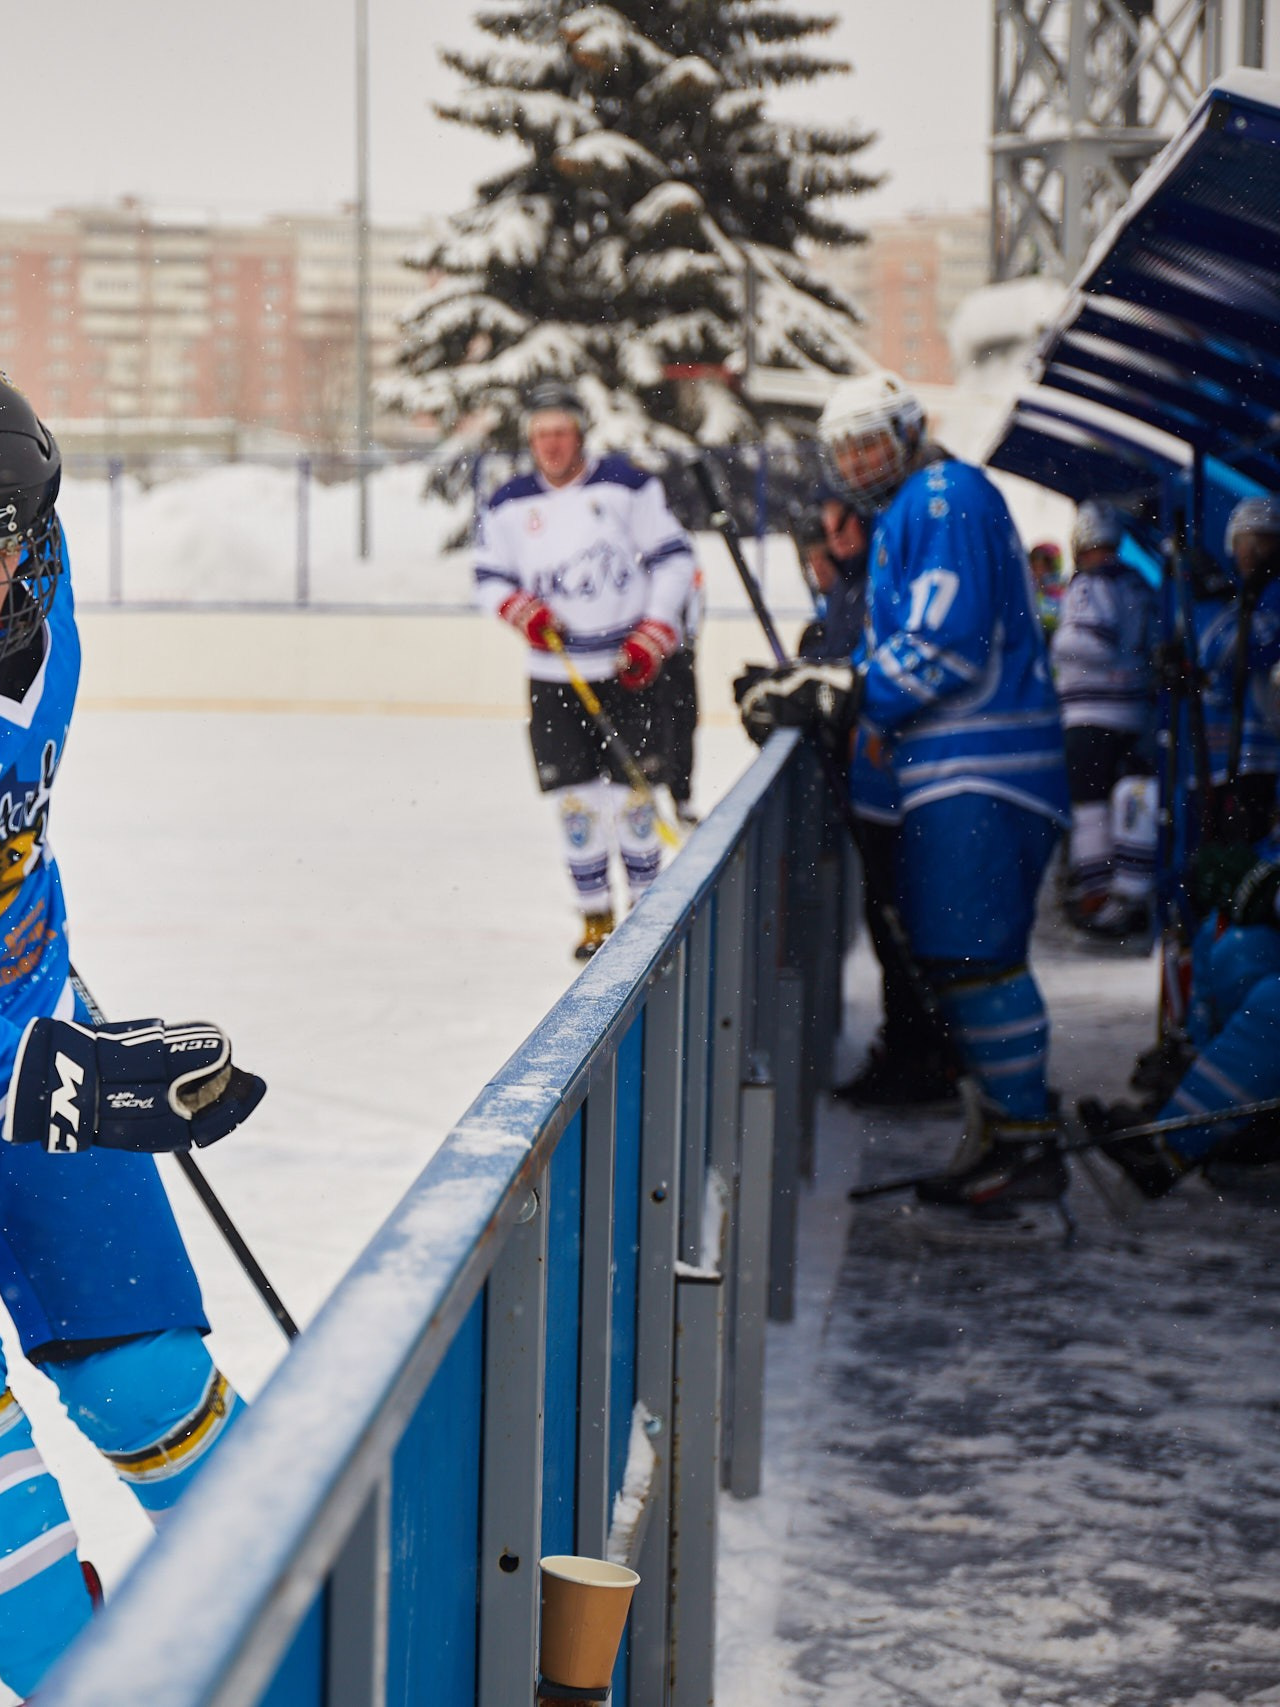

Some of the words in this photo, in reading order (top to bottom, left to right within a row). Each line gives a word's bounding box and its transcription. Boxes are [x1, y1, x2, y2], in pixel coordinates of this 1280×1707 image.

[170, 1038, 219, 1054] CCM
[47, 1051, 85, 1154] CM
[110, 1096, 154, 1110] TACKS
